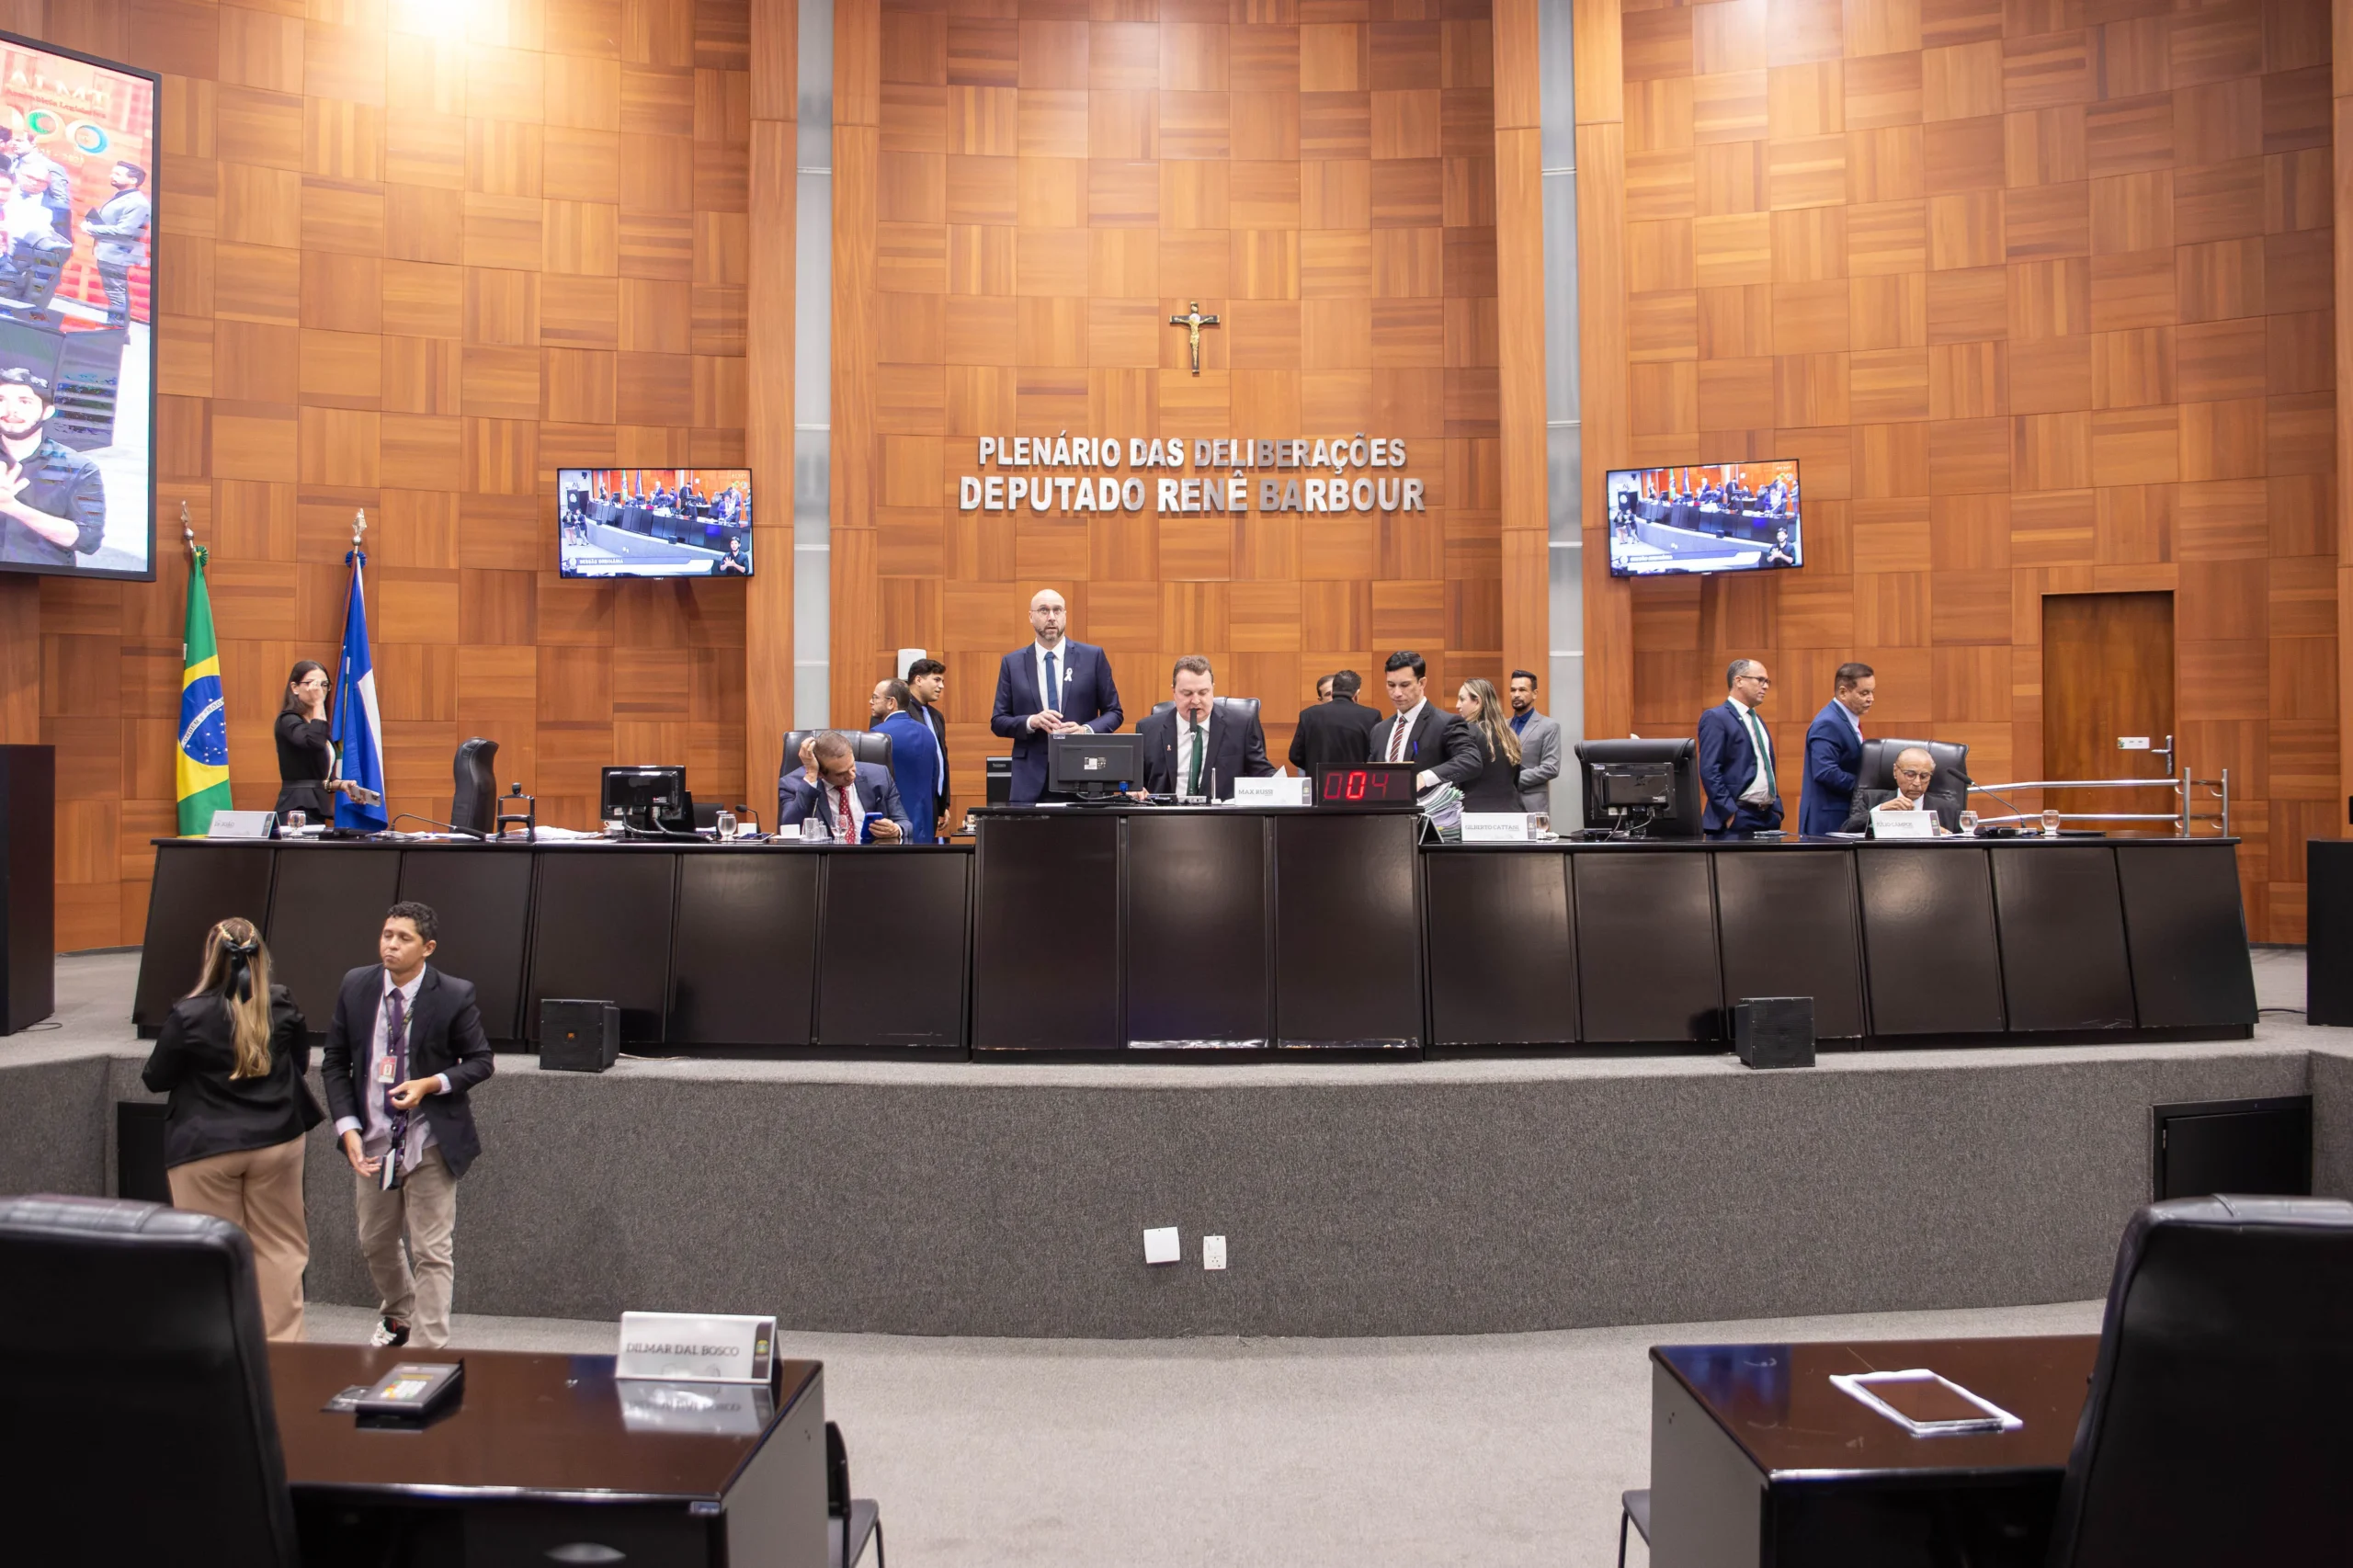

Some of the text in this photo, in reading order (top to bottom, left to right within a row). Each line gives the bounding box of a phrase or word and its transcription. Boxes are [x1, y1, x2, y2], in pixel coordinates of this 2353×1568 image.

[978, 430, 1406, 474] PLENÁRIO DAS DELIBERAÇÕES
[960, 470, 1425, 512] DEPUTADO RENÊ BARBOUR
[183, 719, 200, 743] ORDEM
[626, 1342, 740, 1357] DILMAR DAL BOSCO
